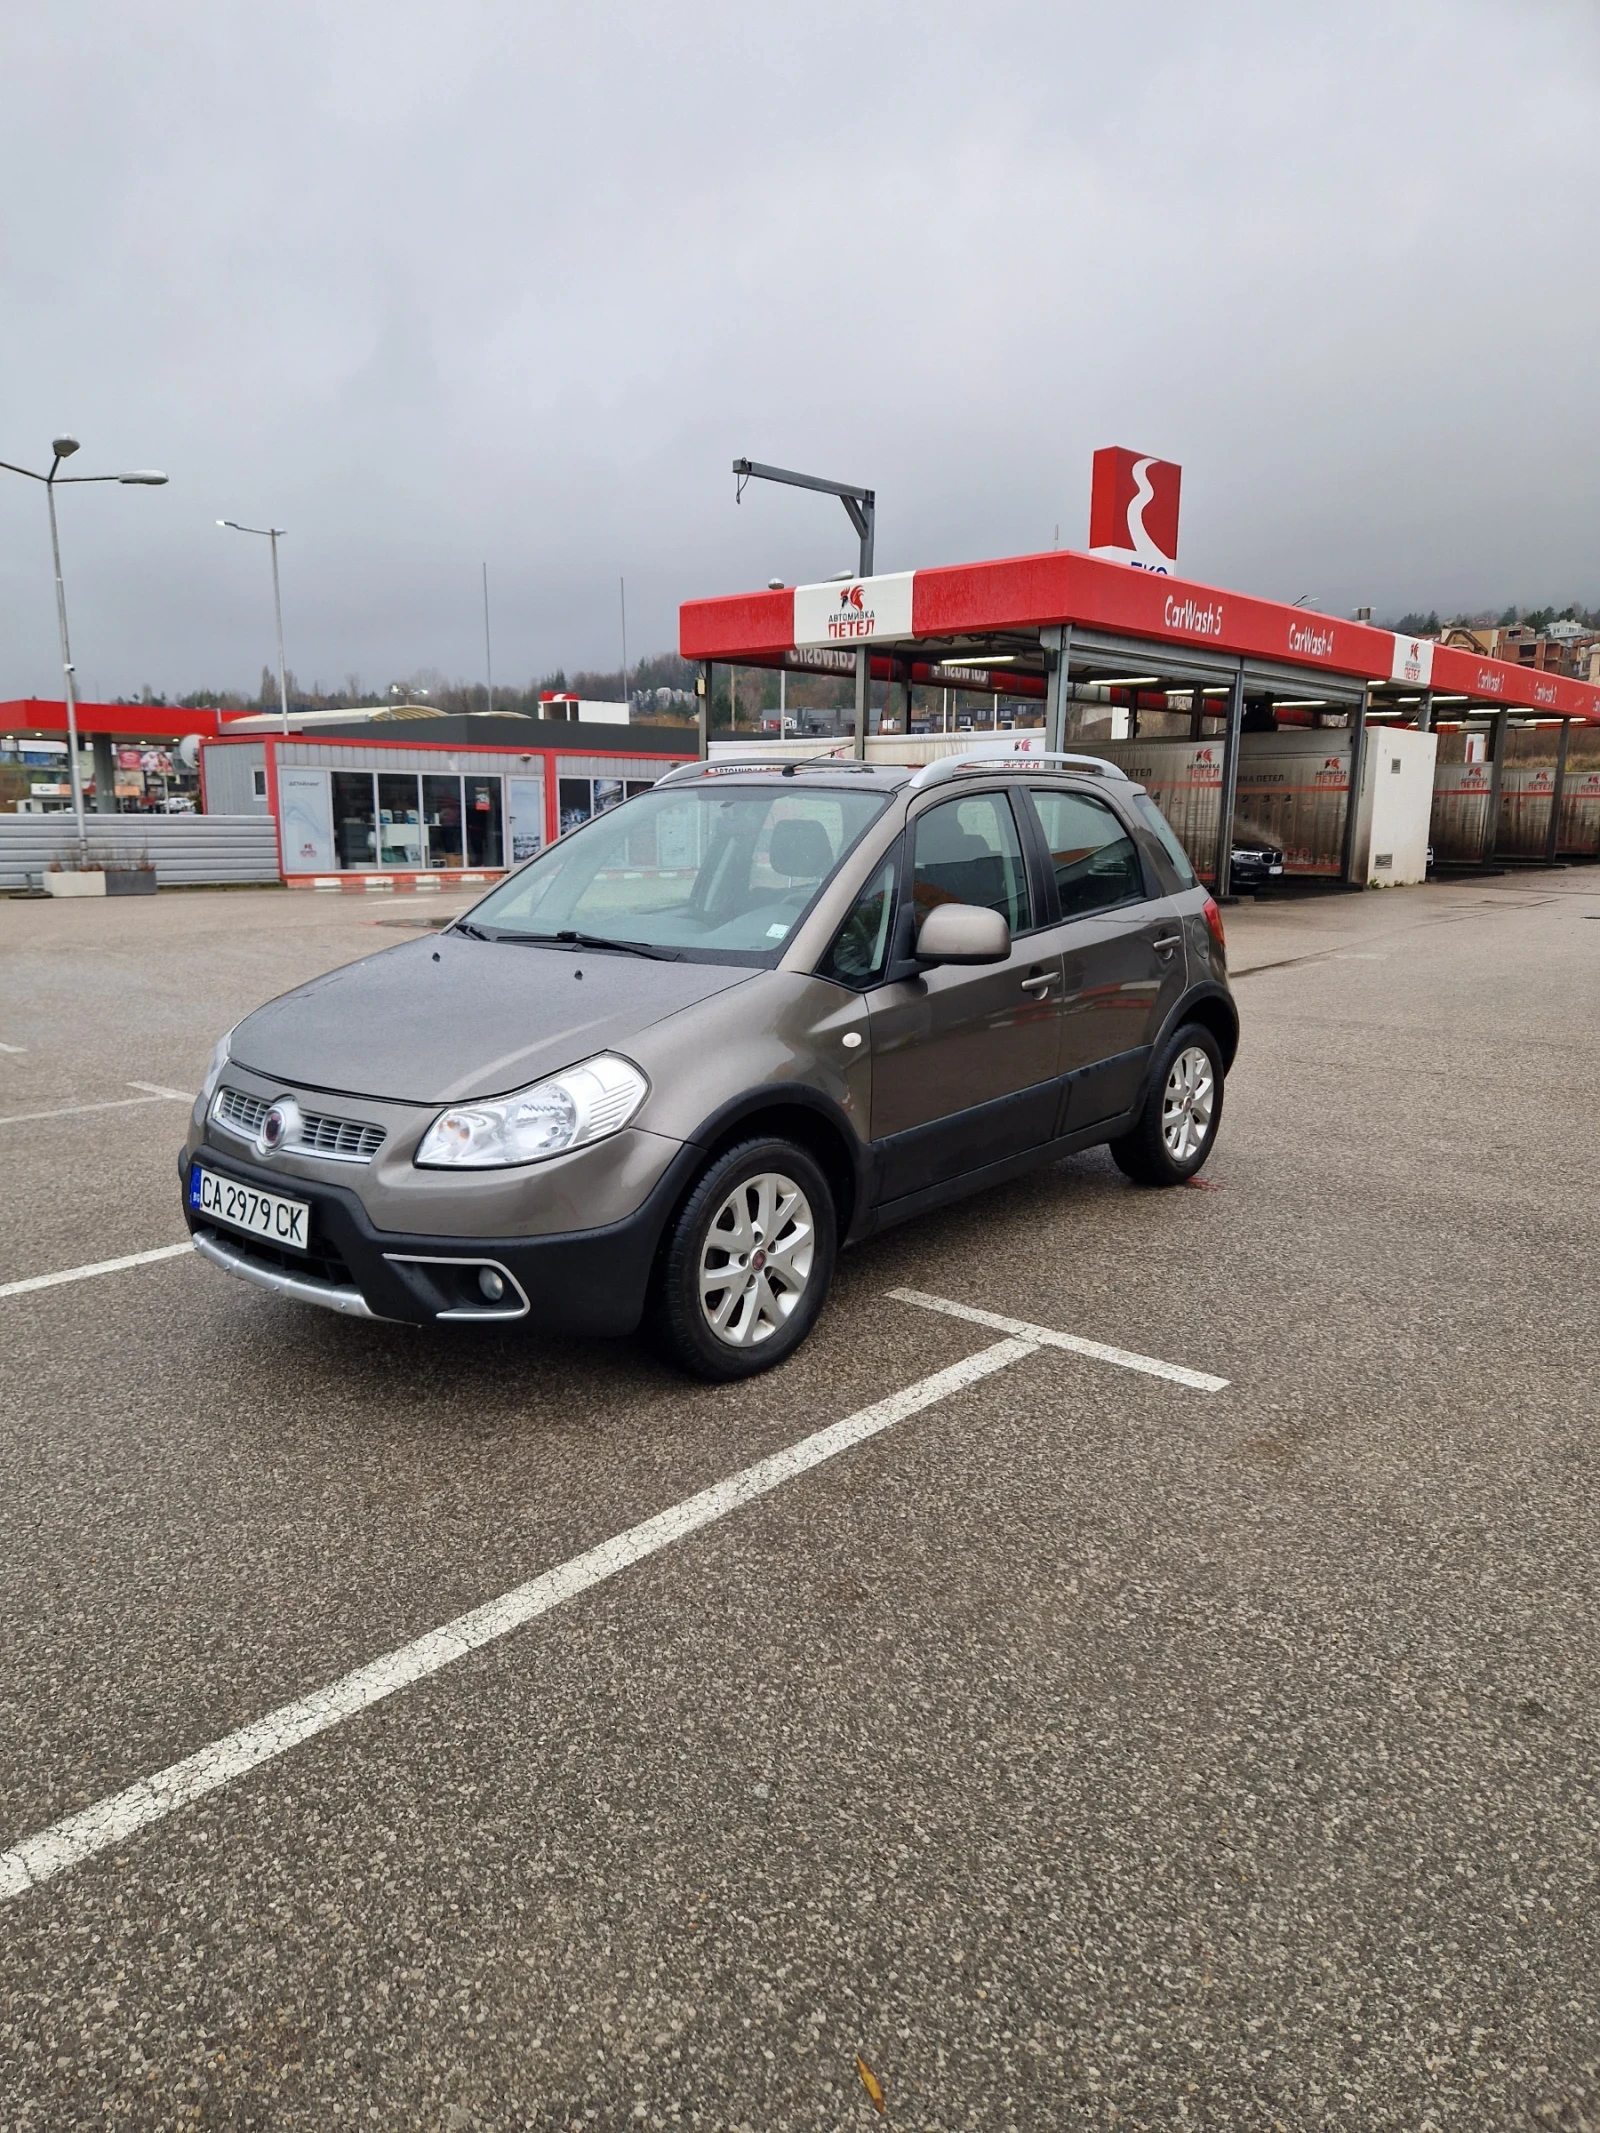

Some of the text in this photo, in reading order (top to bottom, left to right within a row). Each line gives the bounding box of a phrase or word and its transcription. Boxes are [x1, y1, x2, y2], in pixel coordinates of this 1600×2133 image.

[828, 610, 875, 623] АВТОМИВКА
[1164, 594, 1223, 635] CarWash 5
[828, 619, 875, 638] ПЕТЕЛ
[1288, 622, 1334, 657] CarWash 4
[1186, 768, 1220, 779] ПЕТЕЛ
[1256, 774, 1284, 782] ПЕТЕЛ
[1315, 774, 1346, 784] ПЕТЕЛ
[202, 1176, 303, 1243] CA 2979 CK
